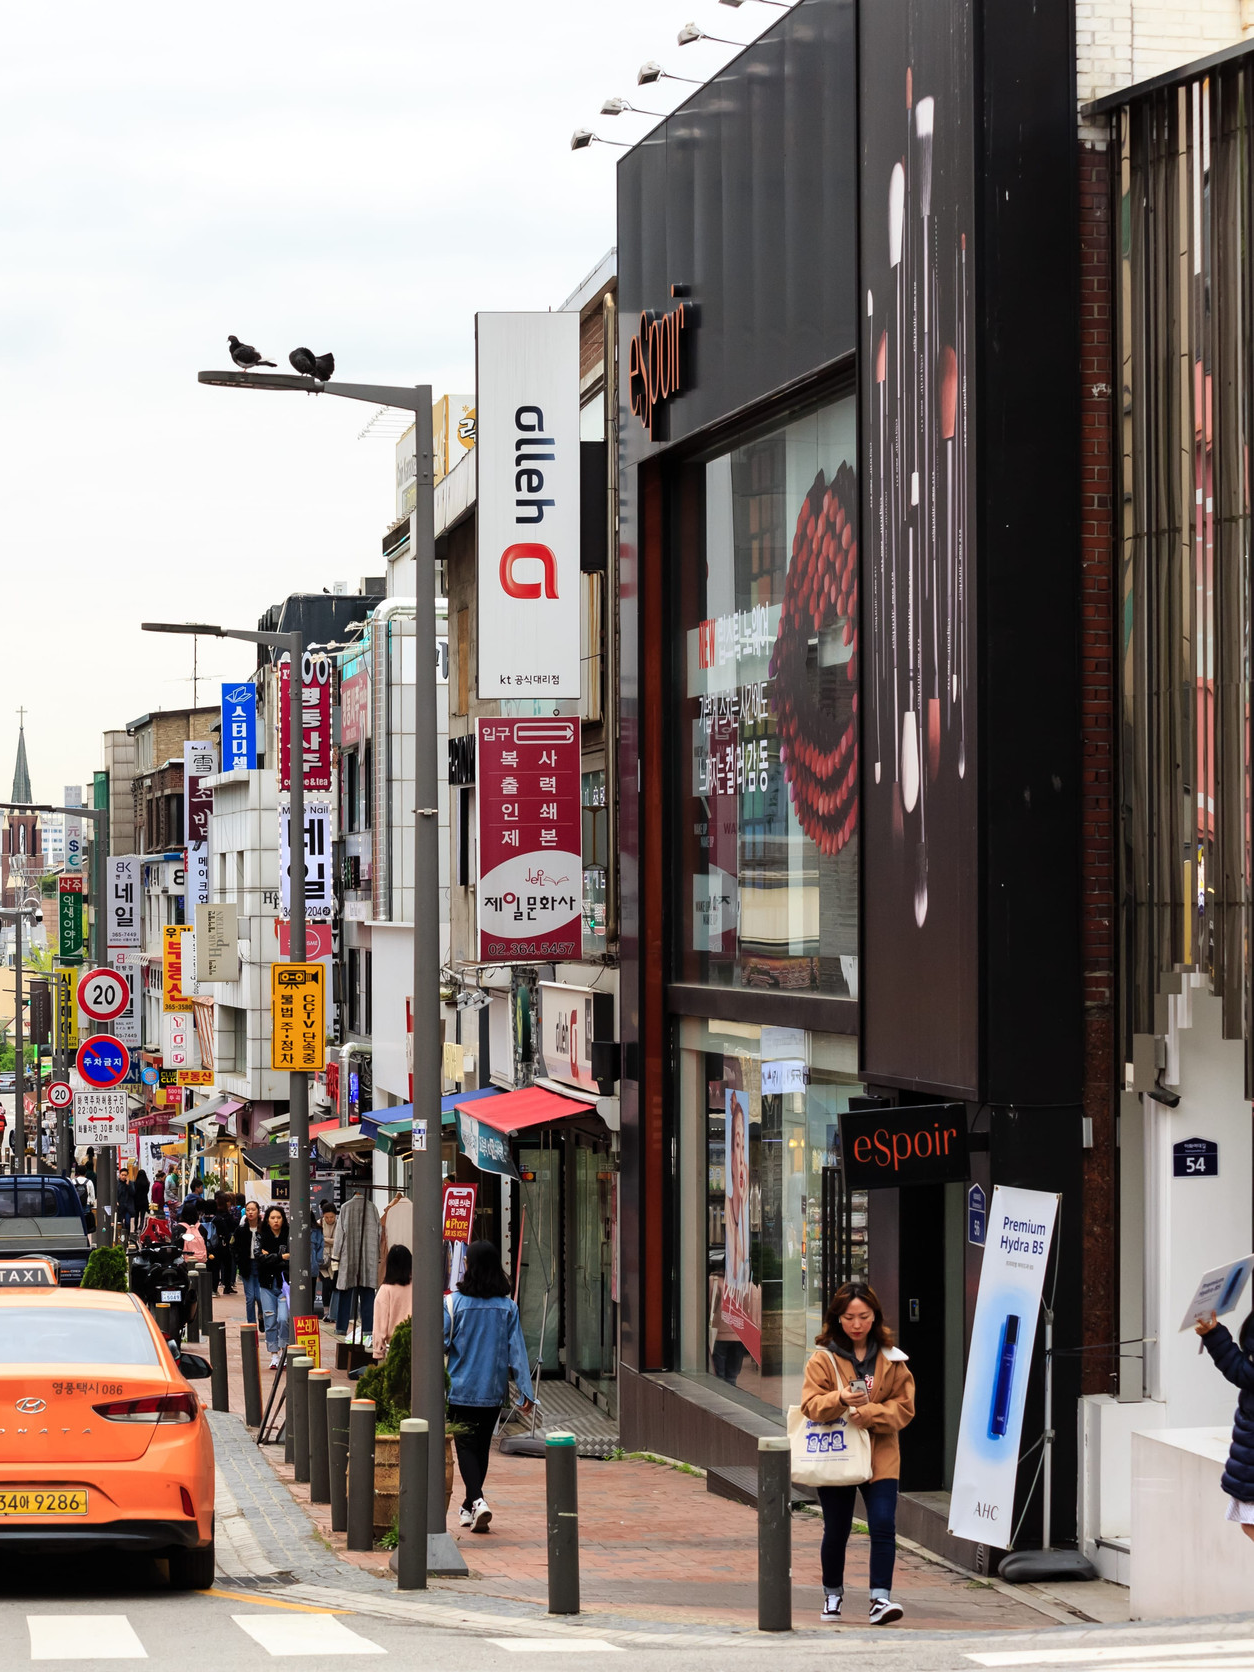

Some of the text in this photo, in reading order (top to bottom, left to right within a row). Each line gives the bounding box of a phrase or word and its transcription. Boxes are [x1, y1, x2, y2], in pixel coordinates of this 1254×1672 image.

[698, 619, 716, 670] NEW
[499, 673, 560, 685] kt 공식대리점
[482, 727, 511, 742] 입구
[310, 806, 329, 814] Nail
[67, 825, 80, 838] 元
[60, 878, 83, 891] 사주
[114, 883, 134, 928] 네일
[484, 891, 576, 921] 제일문화사
[62, 894, 76, 949] 인생이야기
[488, 942, 576, 956] 02.364.5457
[93, 985, 116, 1006] 20
[165, 1003, 193, 1011] 365-3580
[280, 994, 294, 1018] 불법
[302, 994, 317, 1065] CCTV 단속중
[83, 1057, 122, 1067] 주차금지
[179, 1071, 213, 1082] 부동산
[55, 1089, 66, 1100] 20
[94, 1133, 109, 1142] 20m
[1186, 1156, 1207, 1173] 54
[450, 1218, 469, 1230] iPhone
[1003, 1216, 1046, 1236] Premium
[1000, 1235, 1044, 1255] Hydra B5
[296, 1320, 320, 1334] 쓰레기
[52, 1381, 123, 1395] 영풍택시 086
[34, 1493, 80, 1511] 9286
[973, 1501, 1000, 1522] AHC
